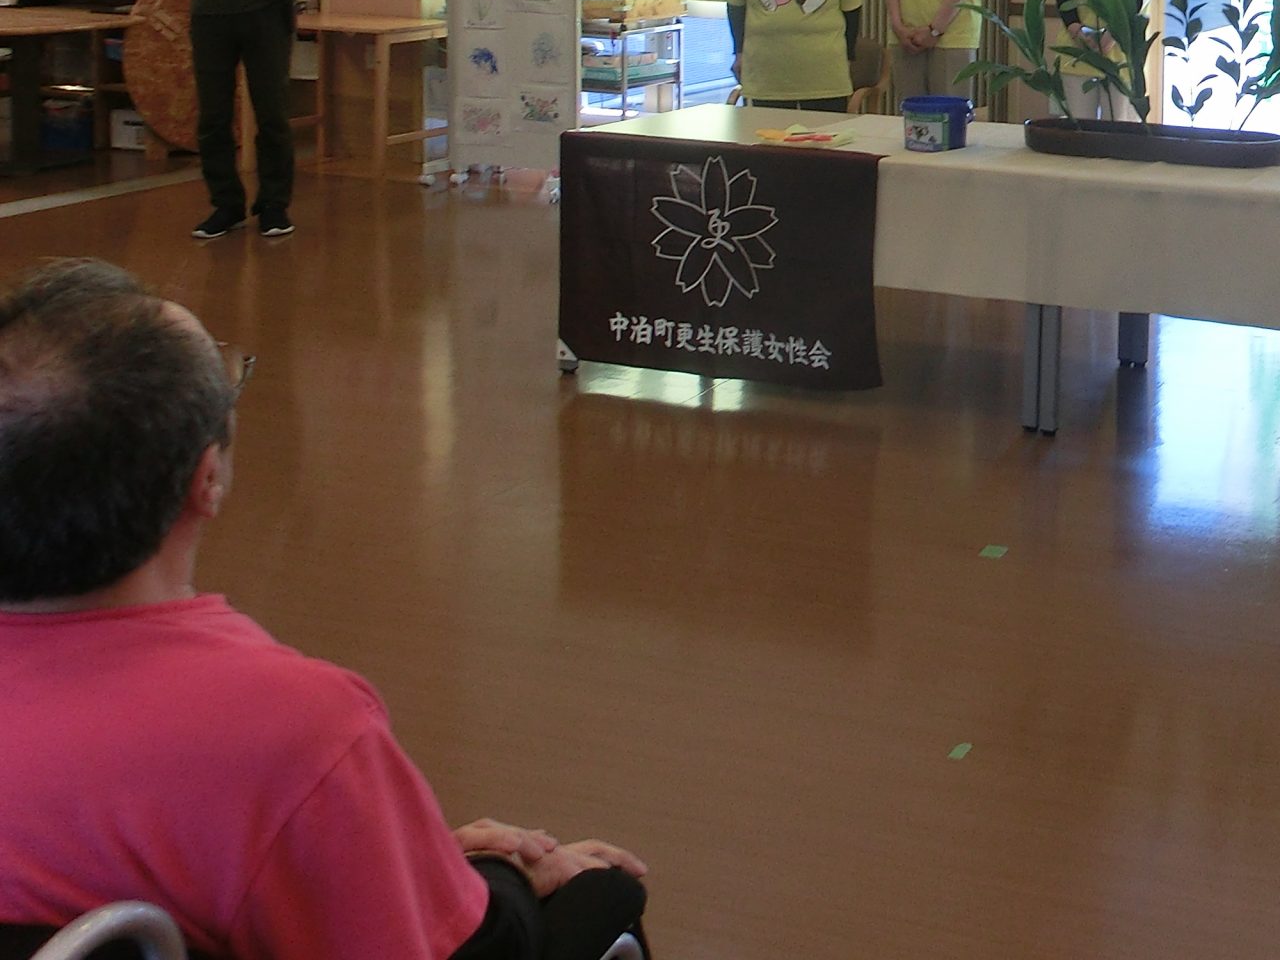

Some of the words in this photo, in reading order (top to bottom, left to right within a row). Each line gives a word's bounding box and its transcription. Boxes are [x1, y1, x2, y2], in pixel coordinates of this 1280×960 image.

[608, 311, 833, 371] 中泊町更生保護女性会
